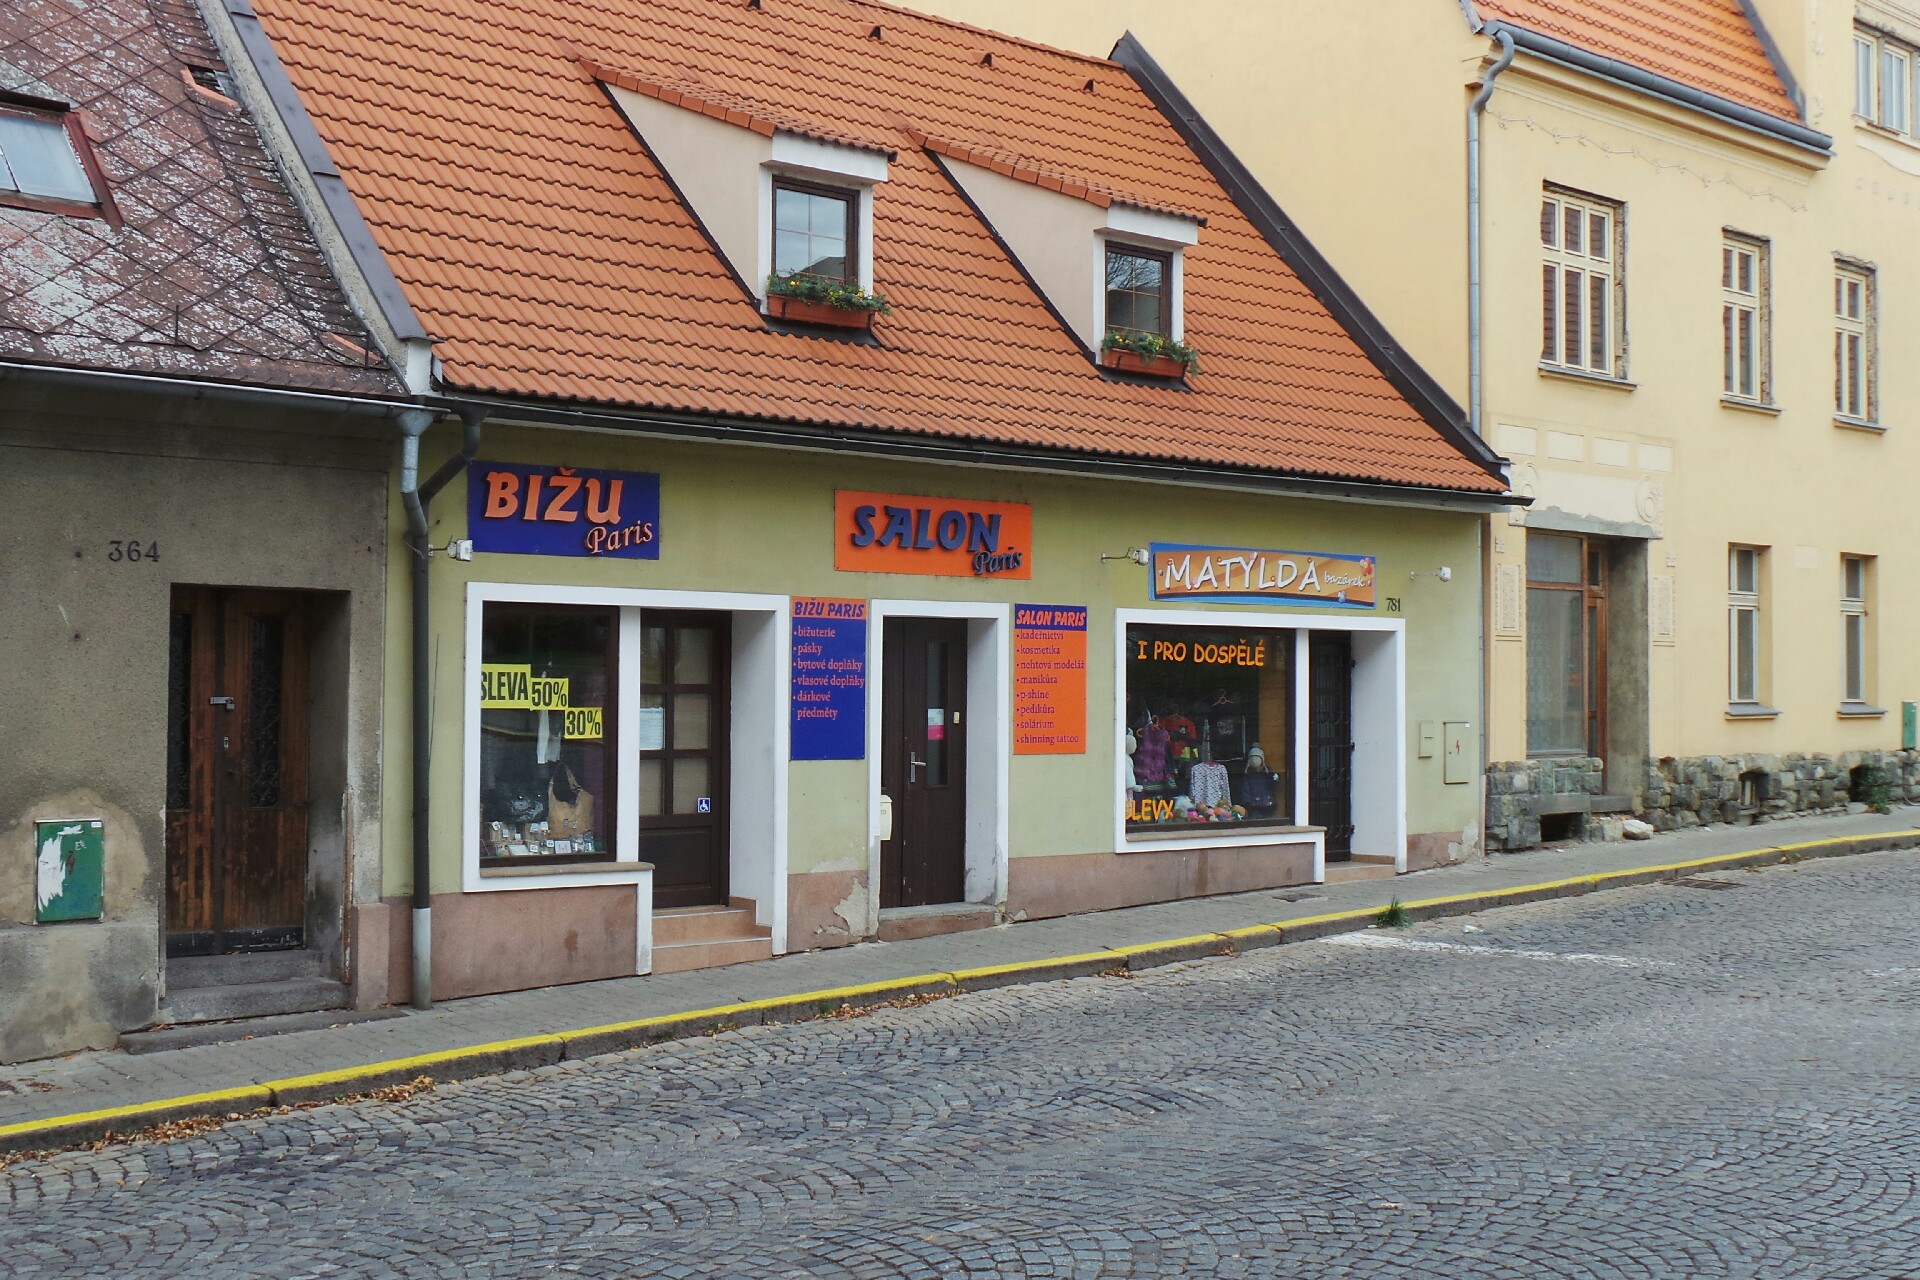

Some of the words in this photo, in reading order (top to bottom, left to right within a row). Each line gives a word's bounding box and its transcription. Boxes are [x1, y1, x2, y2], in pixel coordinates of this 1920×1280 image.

[484, 467, 623, 524] BIŽU
[851, 505, 1002, 553] SALON
[585, 520, 653, 554] Paris
[108, 540, 160, 562] 364
[973, 546, 1023, 575] Paris
[1165, 552, 1321, 592] MATYLDA
[1324, 571, 1365, 587] bazárek
[794, 598, 824, 616] BIŽU
[827, 603, 865, 618] PARIS
[1386, 598, 1400, 612] 781
[1016, 610, 1053, 626] SALON
[1054, 611, 1086, 627] PARIS
[797, 625, 835, 637] bižuterie
[797, 642, 822, 656] pásky
[1020, 644, 1060, 654] kosmetika
[1137, 640, 1148, 660] I
[1154, 640, 1187, 662] PRO
[1193, 638, 1265, 667] DOSPĚLÉ
[797, 658, 826, 671] bytové
[828, 659, 862, 672] doplňky
[1020, 659, 1052, 669] nehtová
[1053, 659, 1085, 669] modeláž
[797, 675, 828, 686] vlasové
[830, 675, 865, 688] doplňky
[532, 681, 567, 707] 50%
[797, 691, 831, 702] dárkové
[1020, 689, 1049, 701] p-shine
[797, 707, 838, 720] předměty
[566, 710, 601, 736] 30%
[1020, 719, 1055, 729] solárium
[1020, 733, 1055, 745] shinning
[1056, 735, 1079, 743] tattoo
